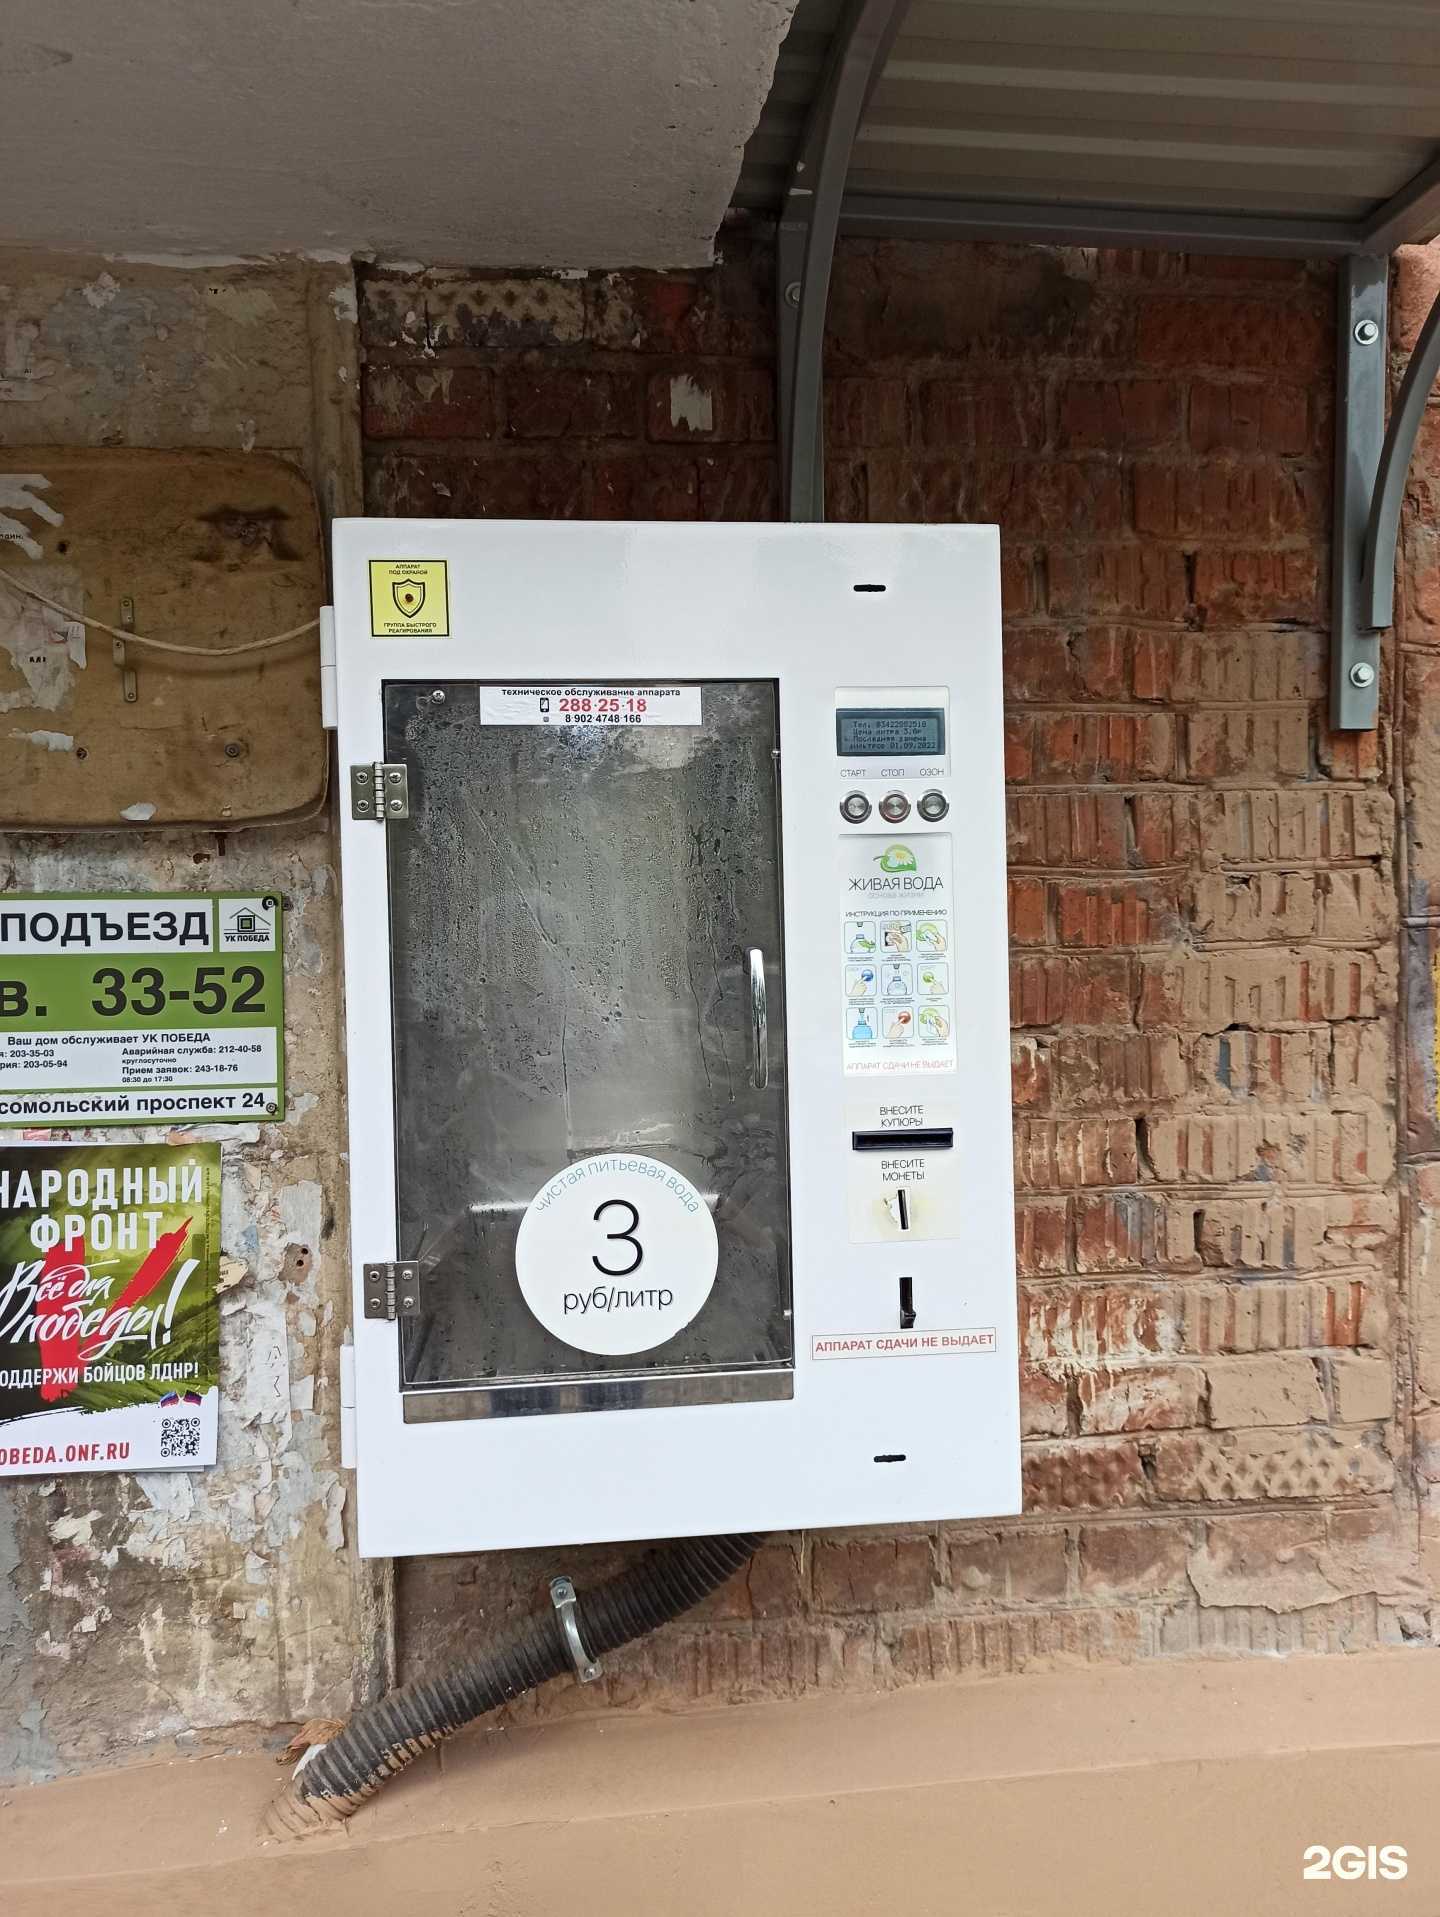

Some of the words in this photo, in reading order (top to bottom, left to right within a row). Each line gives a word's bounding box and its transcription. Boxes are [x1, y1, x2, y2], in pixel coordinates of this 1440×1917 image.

[501, 689, 562, 697] техническое
[564, 687, 635, 698] обслуживание
[636, 689, 681, 698] аппарата
[840, 769, 866, 777] СТАРТ
[881, 768, 905, 777] СТОП
[919, 768, 945, 776] ОЗОН
[848, 877, 900, 891] ЖИВАЯ
[903, 876, 944, 891] ВОДА
[0, 911, 209, 947] ПОДЪЕЗД
[92, 966, 266, 1016] 33-52
[7, 1036, 32, 1045] Ваш
[35, 1037, 58, 1046] дом
[62, 1035, 139, 1046] обслуживает
[142, 1034, 158, 1043] УК
[161, 1033, 211, 1043] ПОБЕДА
[10, 1049, 55, 1058] 203-35-03
[122, 1047, 175, 1056] Аварийная
[177, 1045, 216, 1056] служба:
[218, 1044, 262, 1053] 212-40-58
[23, 1060, 68, 1068] 203-05-94
[122, 1057, 177, 1065] круглосуточно
[122, 1066, 153, 1075] Прием
[155, 1066, 192, 1074] заявок:
[195, 1064, 238, 1073] 243-18-76
[137, 1096, 236, 1114] проспект
[242, 1092, 264, 1108] 24
[880, 1105, 924, 1116] ВНЕСИТЕ
[880, 1117, 923, 1128] КУПЮРЫ
[881, 1159, 925, 1170] ВНЕСИТЕ
[882, 1171, 925, 1182] МОНЕТЫ
[535, 1167, 586, 1211] чистая
[587, 1158, 666, 1182] питьевая
[665, 1176, 699, 1213] вода
[30, 1211, 163, 1253] ФРОНТ
[592, 1199, 643, 1276] 3
[563, 1286, 673, 1314] руб/литр
[816, 1340, 872, 1353] АППАРАТ
[876, 1338, 918, 1351] СДАЧИ
[921, 1336, 938, 1348] НЕ
[941, 1334, 994, 1347] ВЫДАЕТ
[83, 1362, 145, 1383] БОЙЦОВ
[149, 1361, 199, 1382] ЛДНР!
